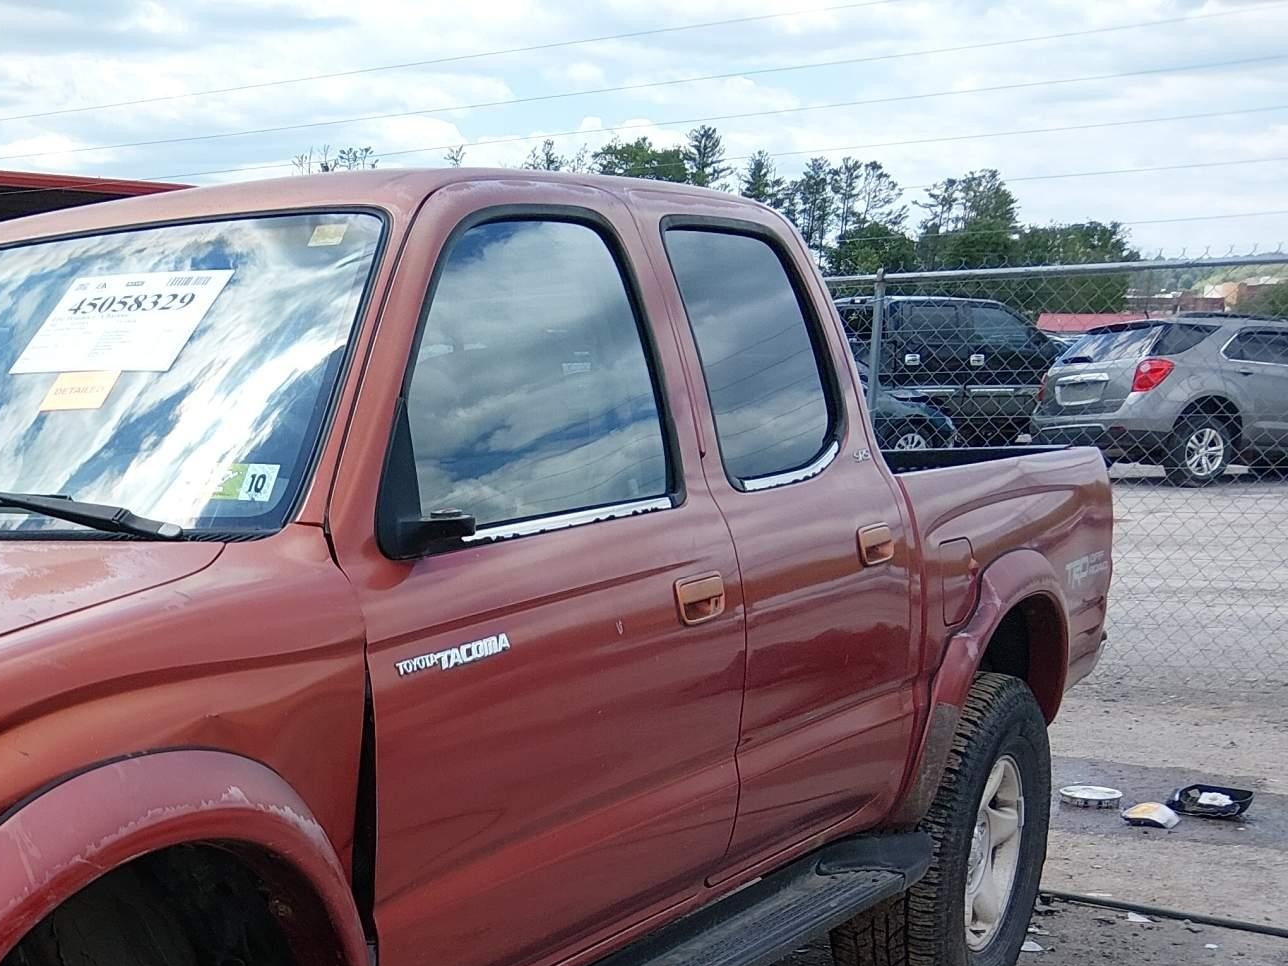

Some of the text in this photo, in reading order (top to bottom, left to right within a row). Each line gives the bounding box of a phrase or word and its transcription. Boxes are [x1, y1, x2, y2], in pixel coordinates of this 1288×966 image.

[68, 292, 196, 315] 45058329
[247, 473, 267, 494] 10
[395, 632, 511, 676] TOYOTA TACOMA
